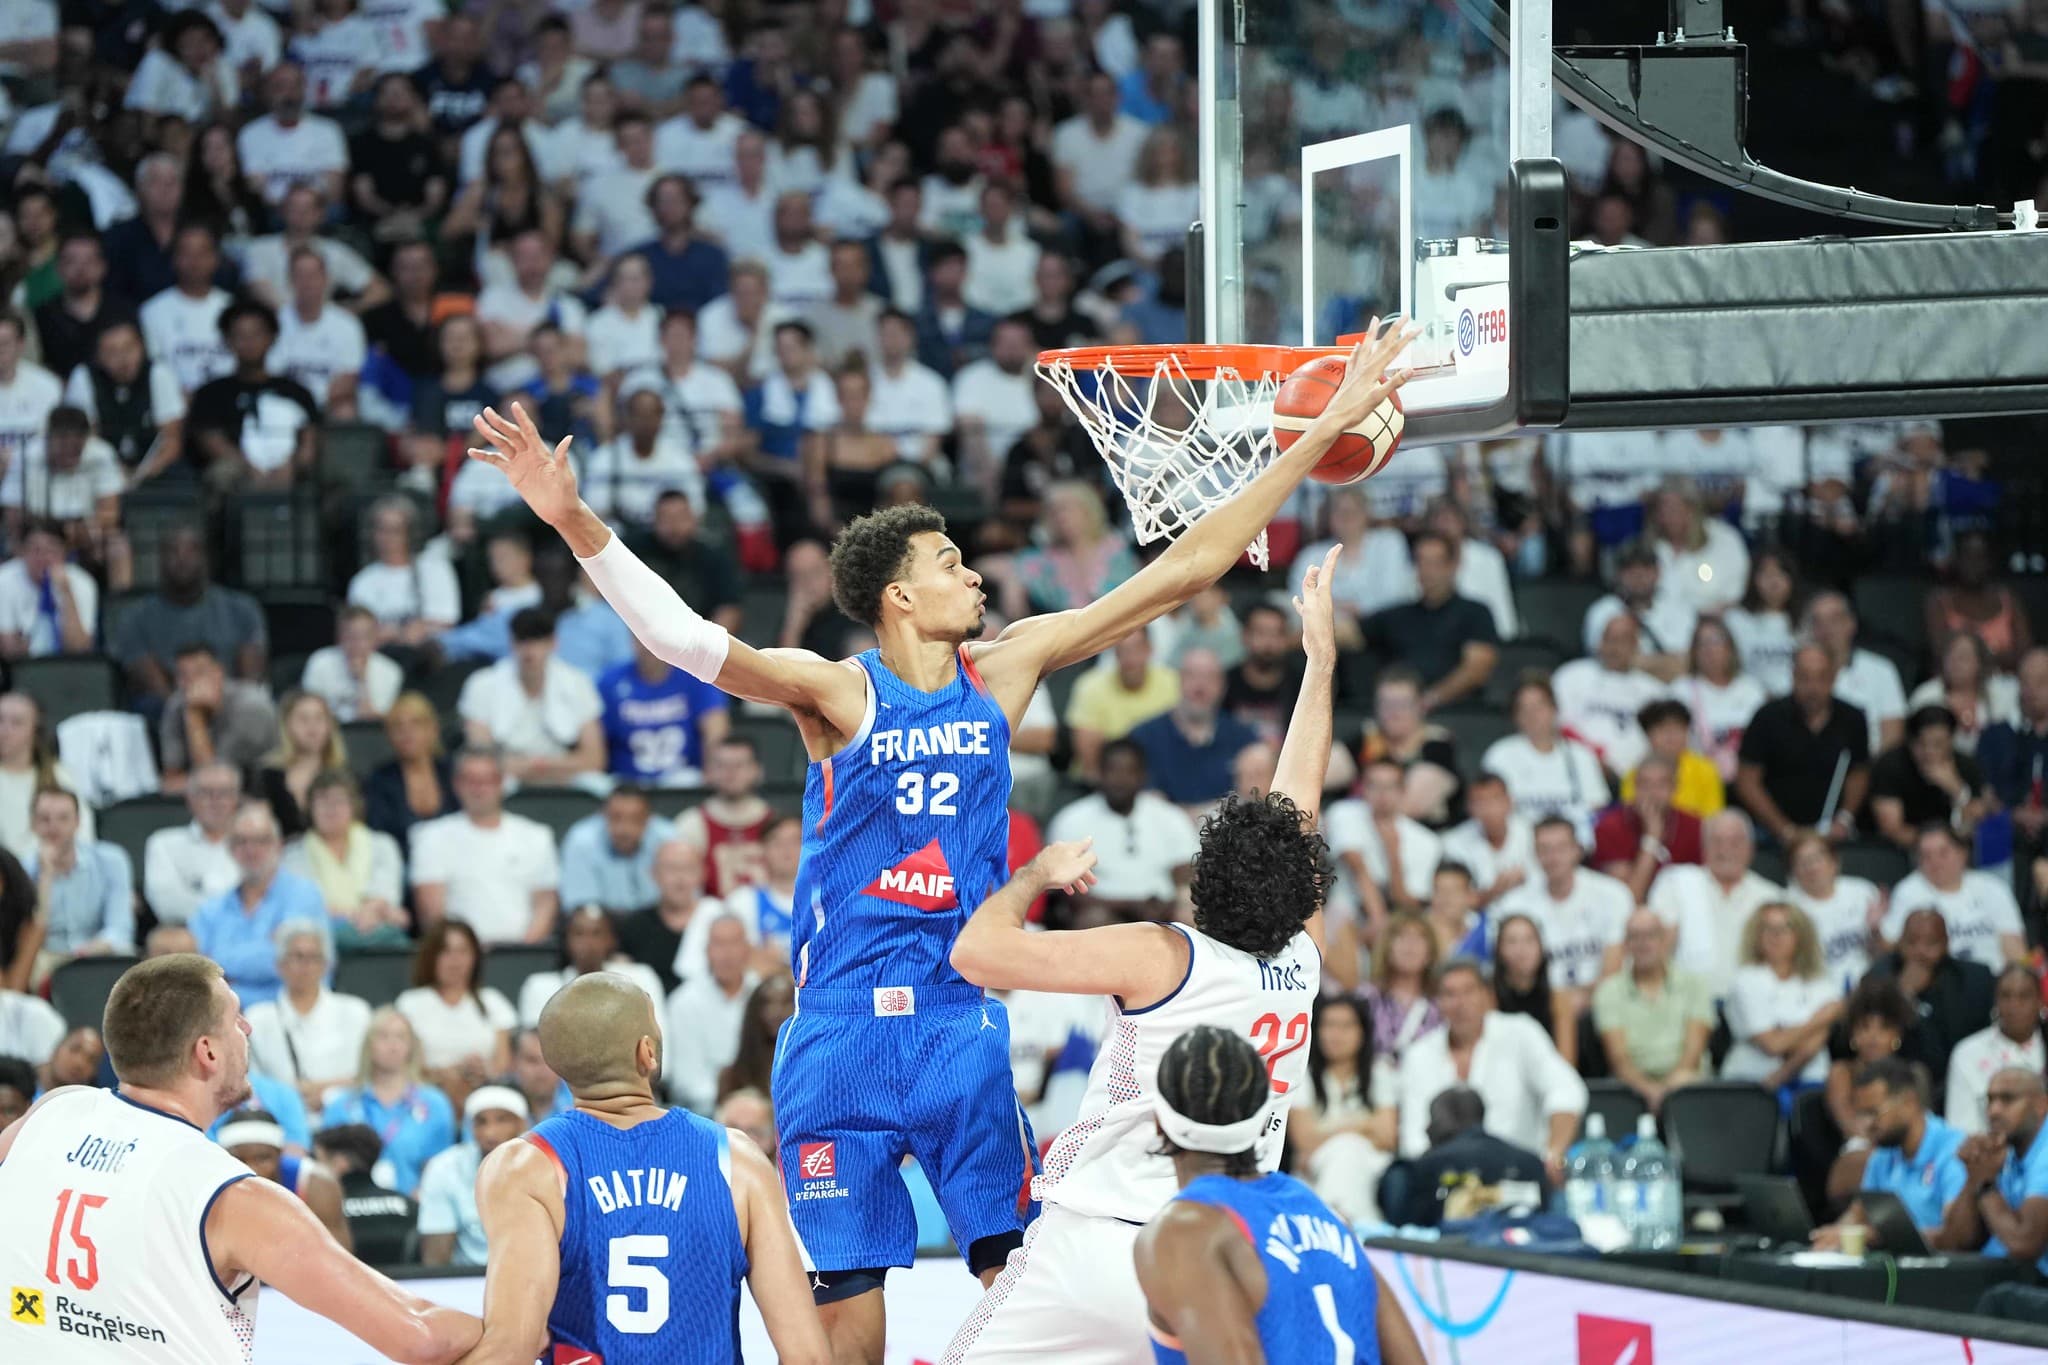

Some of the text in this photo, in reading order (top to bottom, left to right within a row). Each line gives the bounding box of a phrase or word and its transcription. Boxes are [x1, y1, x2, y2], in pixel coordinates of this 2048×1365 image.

[1477, 309, 1506, 345] FFBB
[871, 721, 990, 766] FRANCE
[895, 771, 960, 816] 32
[879, 869, 955, 898] MAIF
[1250, 1012, 1309, 1094] 22
[587, 1166, 689, 1215] BATUM
[803, 1180, 837, 1191] CAISSE
[45, 1188, 109, 1291] 15
[606, 1234, 670, 1335] 5
[59, 1315, 122, 1343] Bank
[1311, 1282, 1356, 1365] 1
